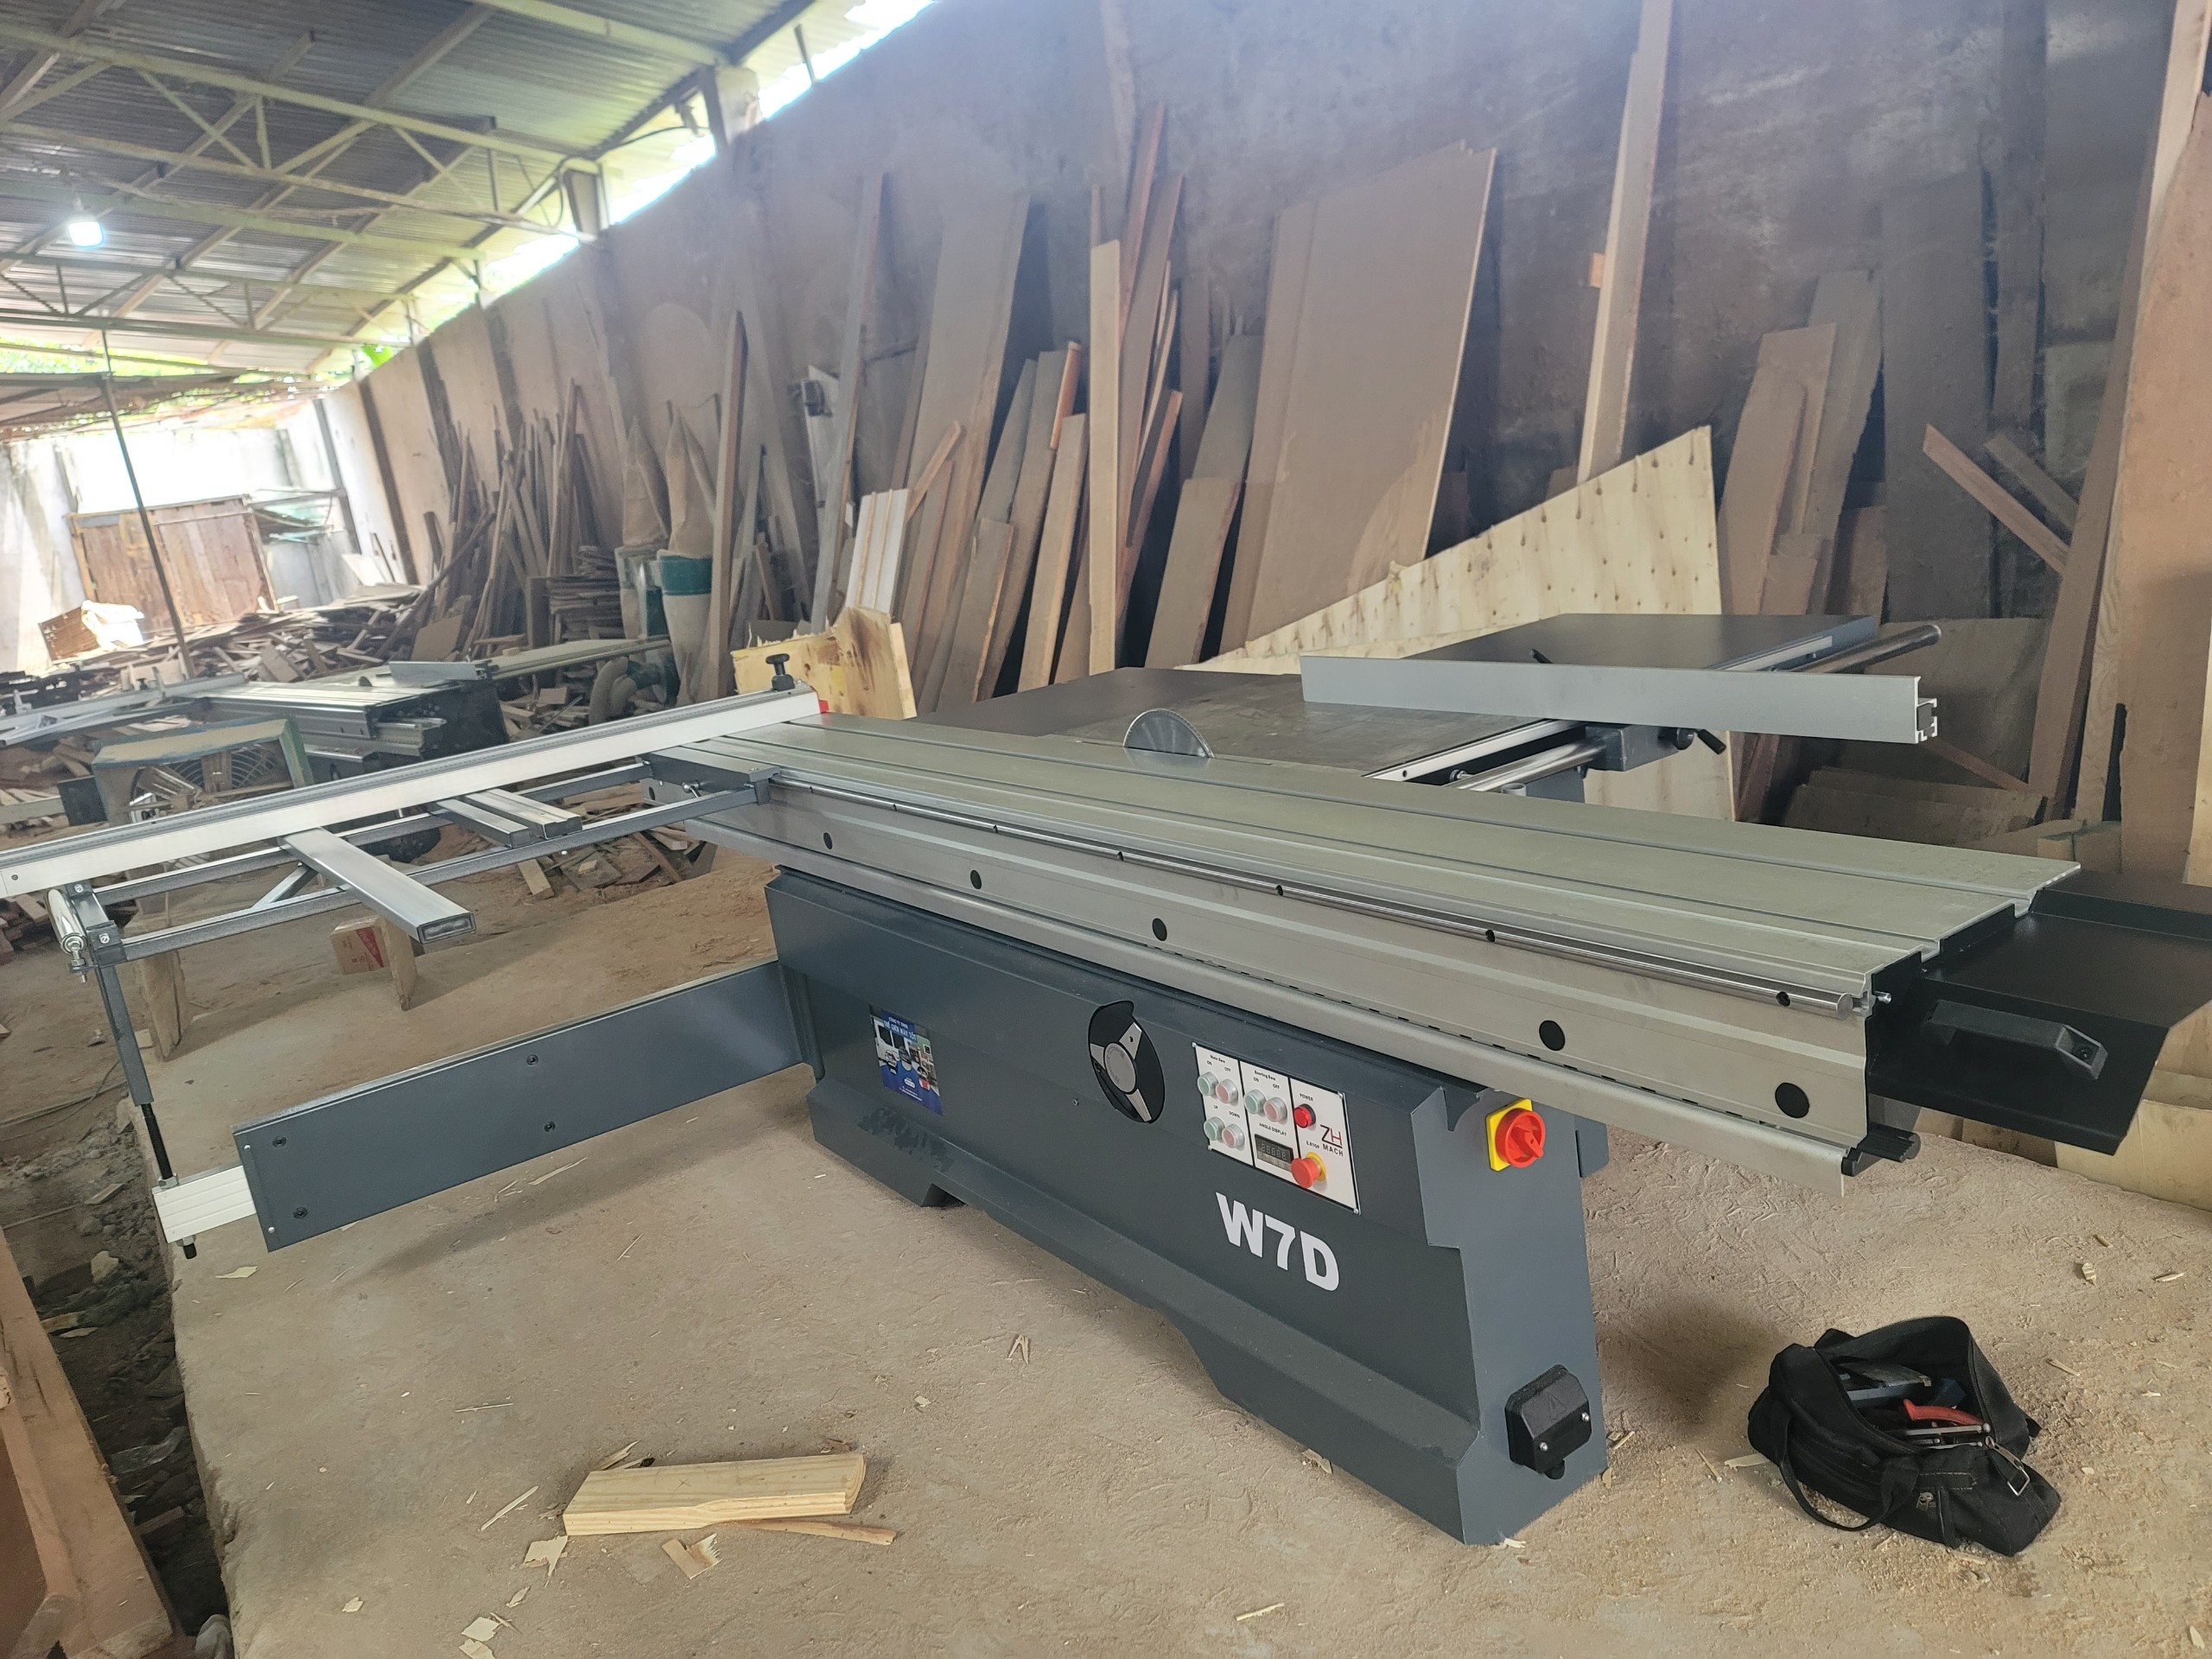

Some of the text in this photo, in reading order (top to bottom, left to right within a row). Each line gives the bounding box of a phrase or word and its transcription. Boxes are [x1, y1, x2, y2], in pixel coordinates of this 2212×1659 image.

[1272, 1127, 1287, 1135] DISPLAY
[1320, 1124, 1343, 1148] ZH
[1322, 1143, 1344, 1157] MACH
[1216, 1192, 1339, 1291] W7D
